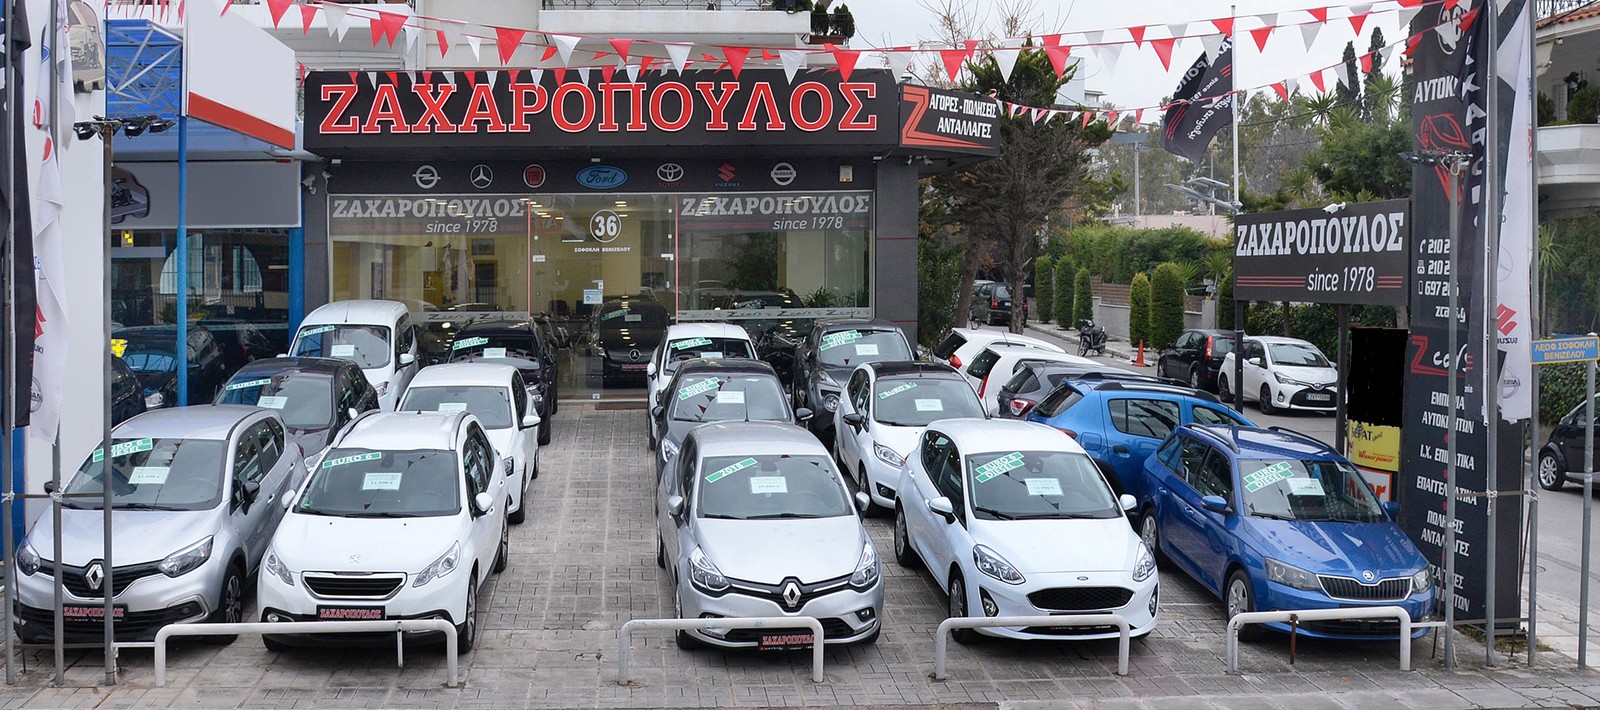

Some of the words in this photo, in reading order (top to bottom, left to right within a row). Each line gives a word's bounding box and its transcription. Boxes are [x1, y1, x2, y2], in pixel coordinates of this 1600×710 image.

[319, 81, 878, 135] ΖΑΧΑΡΟΠΟΥΛΟΣ
[929, 93, 959, 113] ΑΓΟΡΕΣ
[962, 98, 997, 118] ΠΩΛΗΣΕΙΣ
[936, 116, 992, 139] ΑΝΤΑΛΛΑΓΕΣ
[586, 169, 618, 184] Ford
[333, 199, 526, 218] ΖΑΧΑΡΟΠΟΥΛΟΣ
[681, 196, 870, 216] ΖΑΧΑΡΟΠΟΥΛΟΣ
[426, 221, 461, 233] since
[466, 220, 498, 233] 1978
[594, 215, 617, 237] 36
[773, 217, 807, 230] since
[811, 216, 844, 230] 1978
[1236, 212, 1404, 257] ΖΑΧΑΡΟΠΟΥΛΟΣ
[1307, 267, 1339, 291] since
[1343, 266, 1375, 292] 1978
[1535, 343, 1556, 352] ΛΕΩΦ
[1558, 340, 1595, 351] ΣΟΦΟΚΛΗ
[1544, 350, 1586, 360] ΒΕΝΙΖΕΛΟΥ
[110, 441, 133, 451] URO
[331, 455, 362, 466] EURO
[983, 456, 1009, 471] EURO
[987, 462, 1014, 479] DIESEL
[1252, 467, 1276, 481] EURO
[1256, 473, 1286, 487] DIESEL
